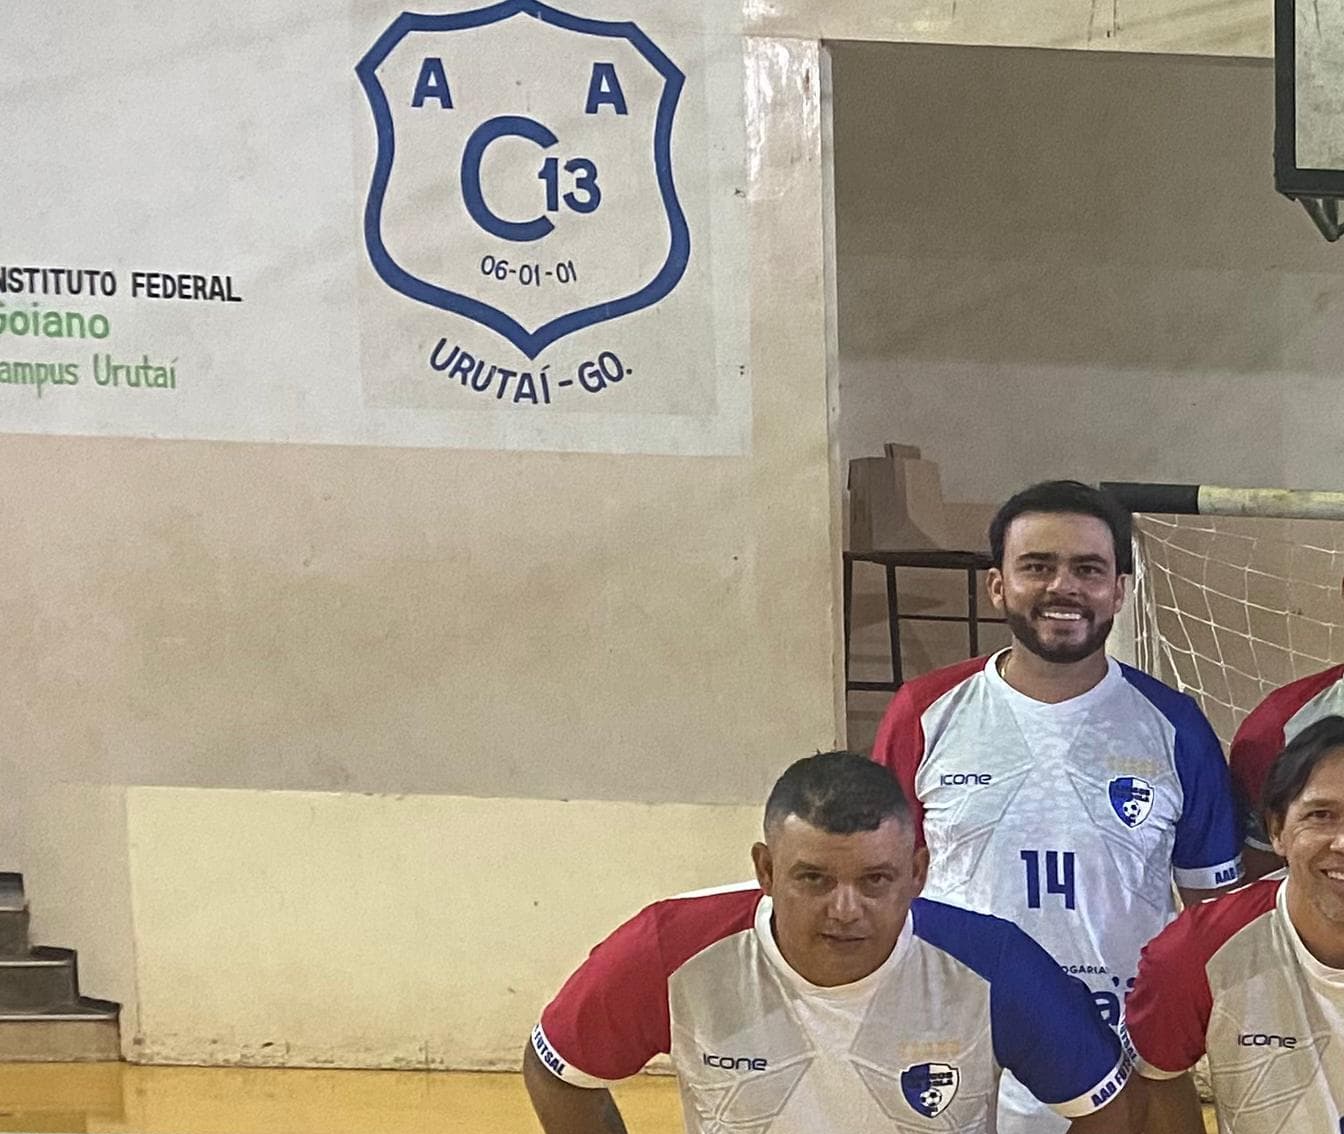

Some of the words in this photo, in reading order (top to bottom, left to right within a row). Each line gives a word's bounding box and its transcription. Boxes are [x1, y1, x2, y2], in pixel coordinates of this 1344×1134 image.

[411, 57, 453, 109] A
[585, 63, 628, 115] A
[131, 272, 242, 302] FEDERAL
[480, 255, 577, 287] 06-01-01
[93, 353, 178, 389] Urutaí
[1020, 850, 1076, 910] 14
